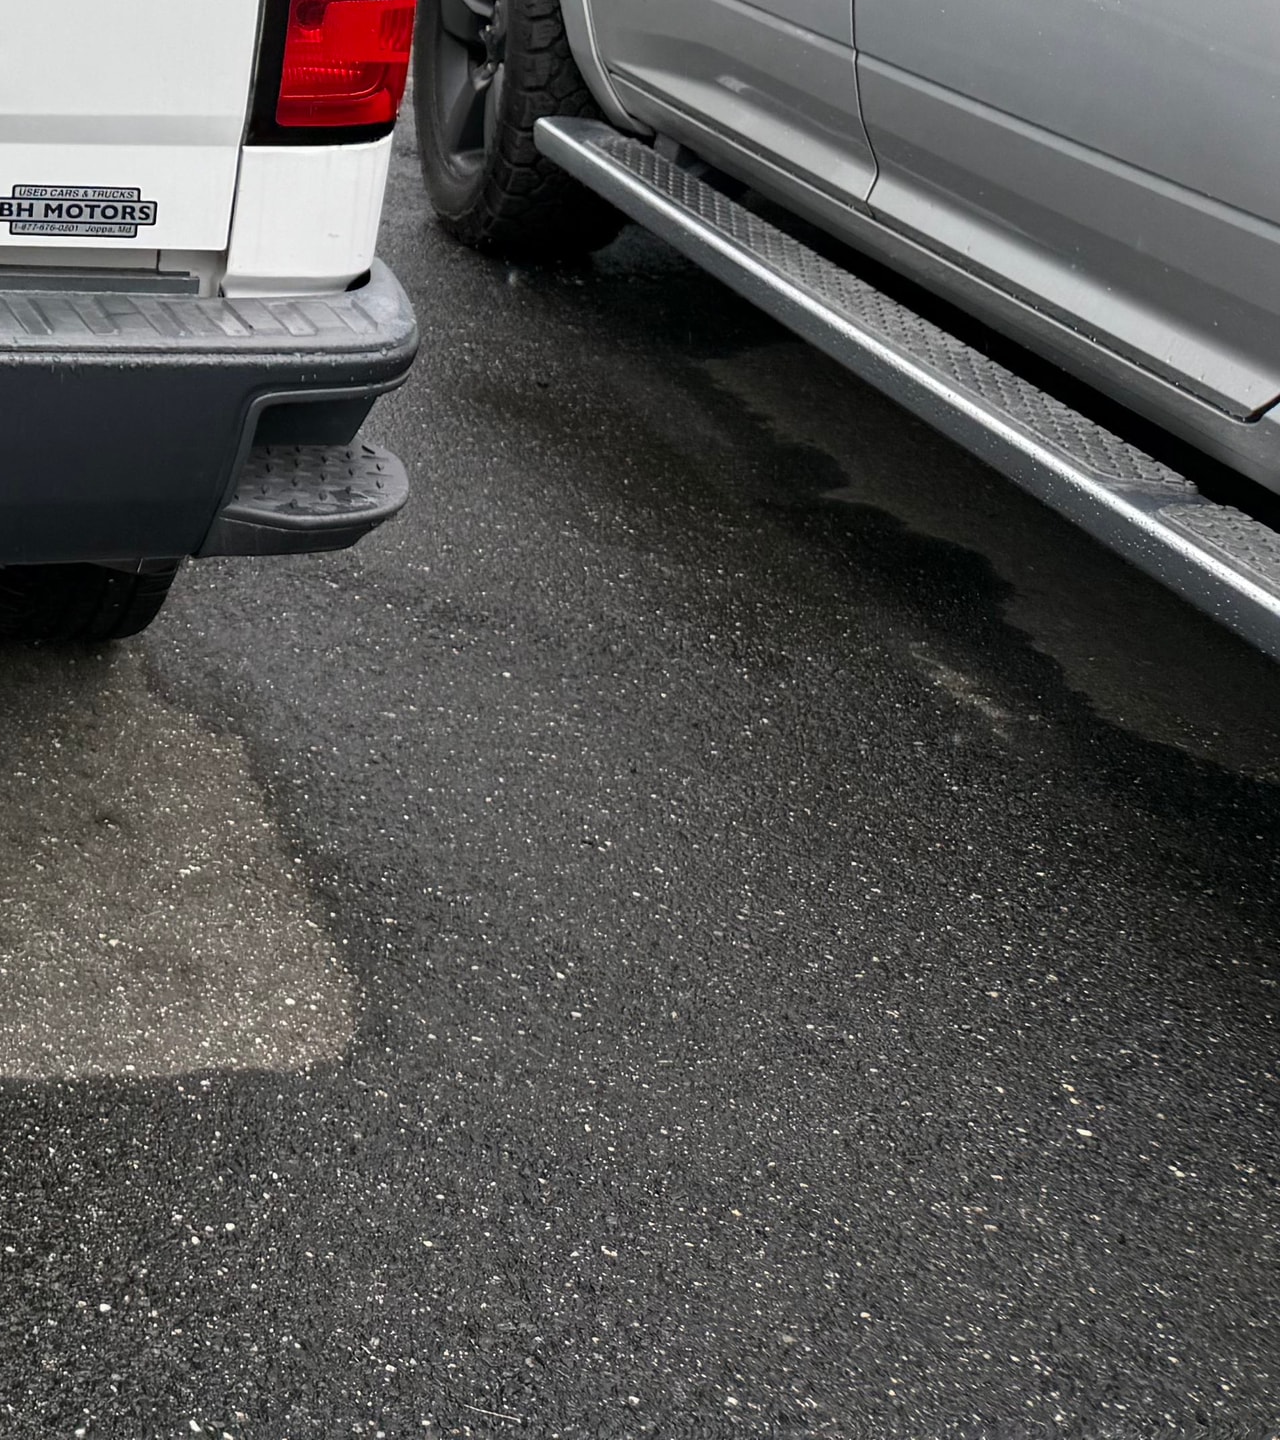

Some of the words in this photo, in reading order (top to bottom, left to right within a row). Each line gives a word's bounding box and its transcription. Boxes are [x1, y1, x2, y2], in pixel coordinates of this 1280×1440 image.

[19, 188, 47, 197] USED
[50, 189, 79, 198] CARS
[81, 190, 89, 198] &
[92, 190, 135, 199] TRUCKS
[43, 203, 151, 221] MOTORS
